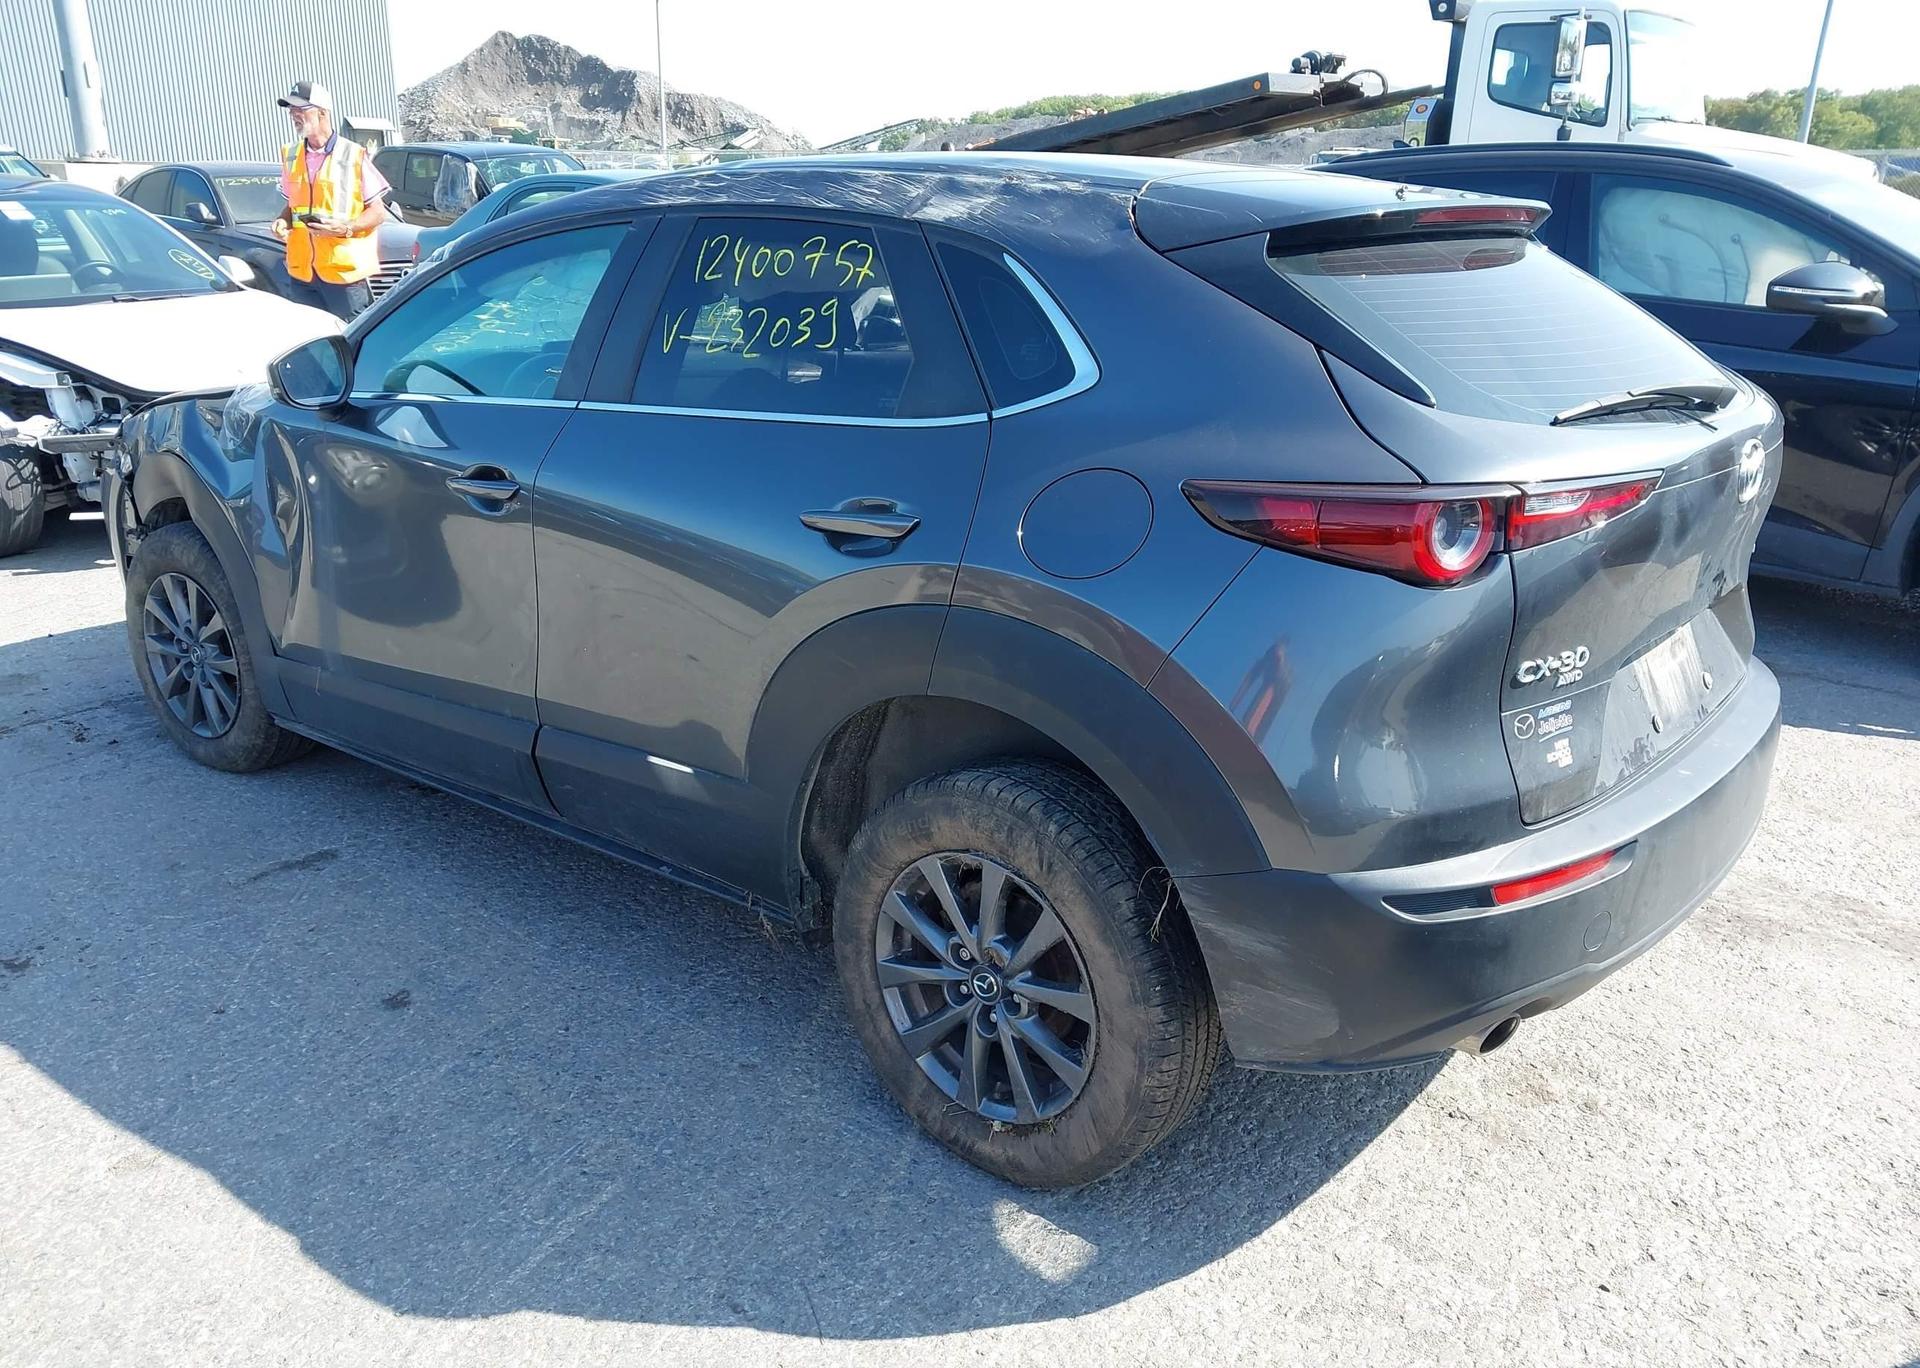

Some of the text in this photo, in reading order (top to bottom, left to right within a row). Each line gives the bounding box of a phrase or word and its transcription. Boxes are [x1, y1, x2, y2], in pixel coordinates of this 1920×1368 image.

[695, 234, 875, 288] 12400757
[1517, 645, 1590, 683] CX-30
[1555, 668, 1583, 688] AWD
